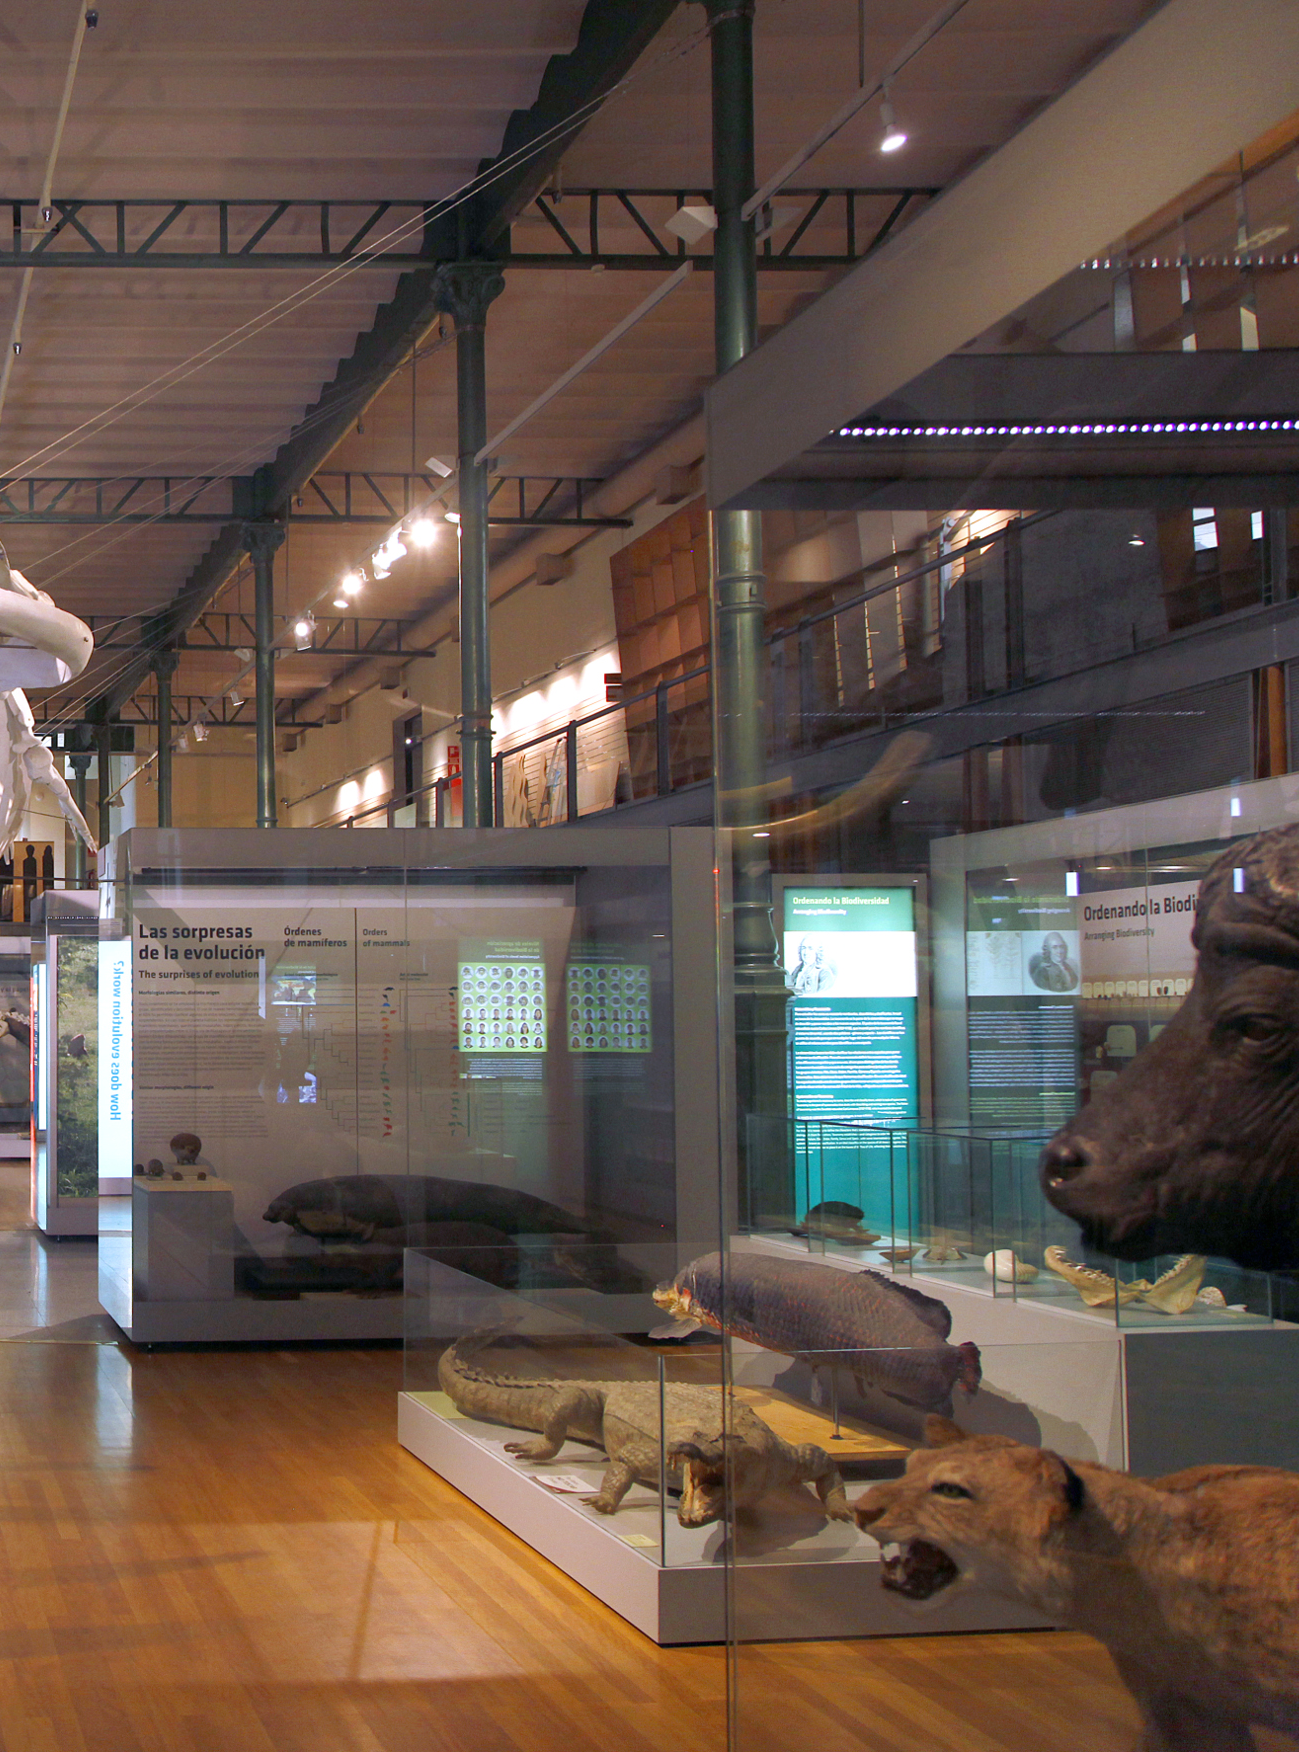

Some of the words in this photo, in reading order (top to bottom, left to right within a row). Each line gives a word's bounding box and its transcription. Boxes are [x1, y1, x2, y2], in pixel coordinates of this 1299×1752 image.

[792, 896, 832, 905] Ordenando
[833, 896, 840, 905] la
[841, 896, 890, 905] Biodiversidad
[1083, 900, 1146, 922] Ordenando
[1149, 898, 1160, 915] la
[139, 924, 167, 938] Las
[172, 926, 253, 942] sorpresas
[283, 925, 322, 936] Órdenes
[362, 928, 388, 936] Orders
[1084, 930, 1115, 942] Arranging
[1116, 927, 1155, 939] Biodiversity
[283, 938, 295, 947] de
[297, 938, 348, 947] mamíferos
[362, 939, 372, 947] of
[372, 939, 411, 947] mammals
[139, 944, 159, 960] de
[164, 944, 179, 960] la
[183, 944, 265, 960] evolución
[138, 970, 156, 979] The
[158, 970, 201, 980] surprises
[202, 969, 213, 979] of
[214, 970, 259, 979] evolution
